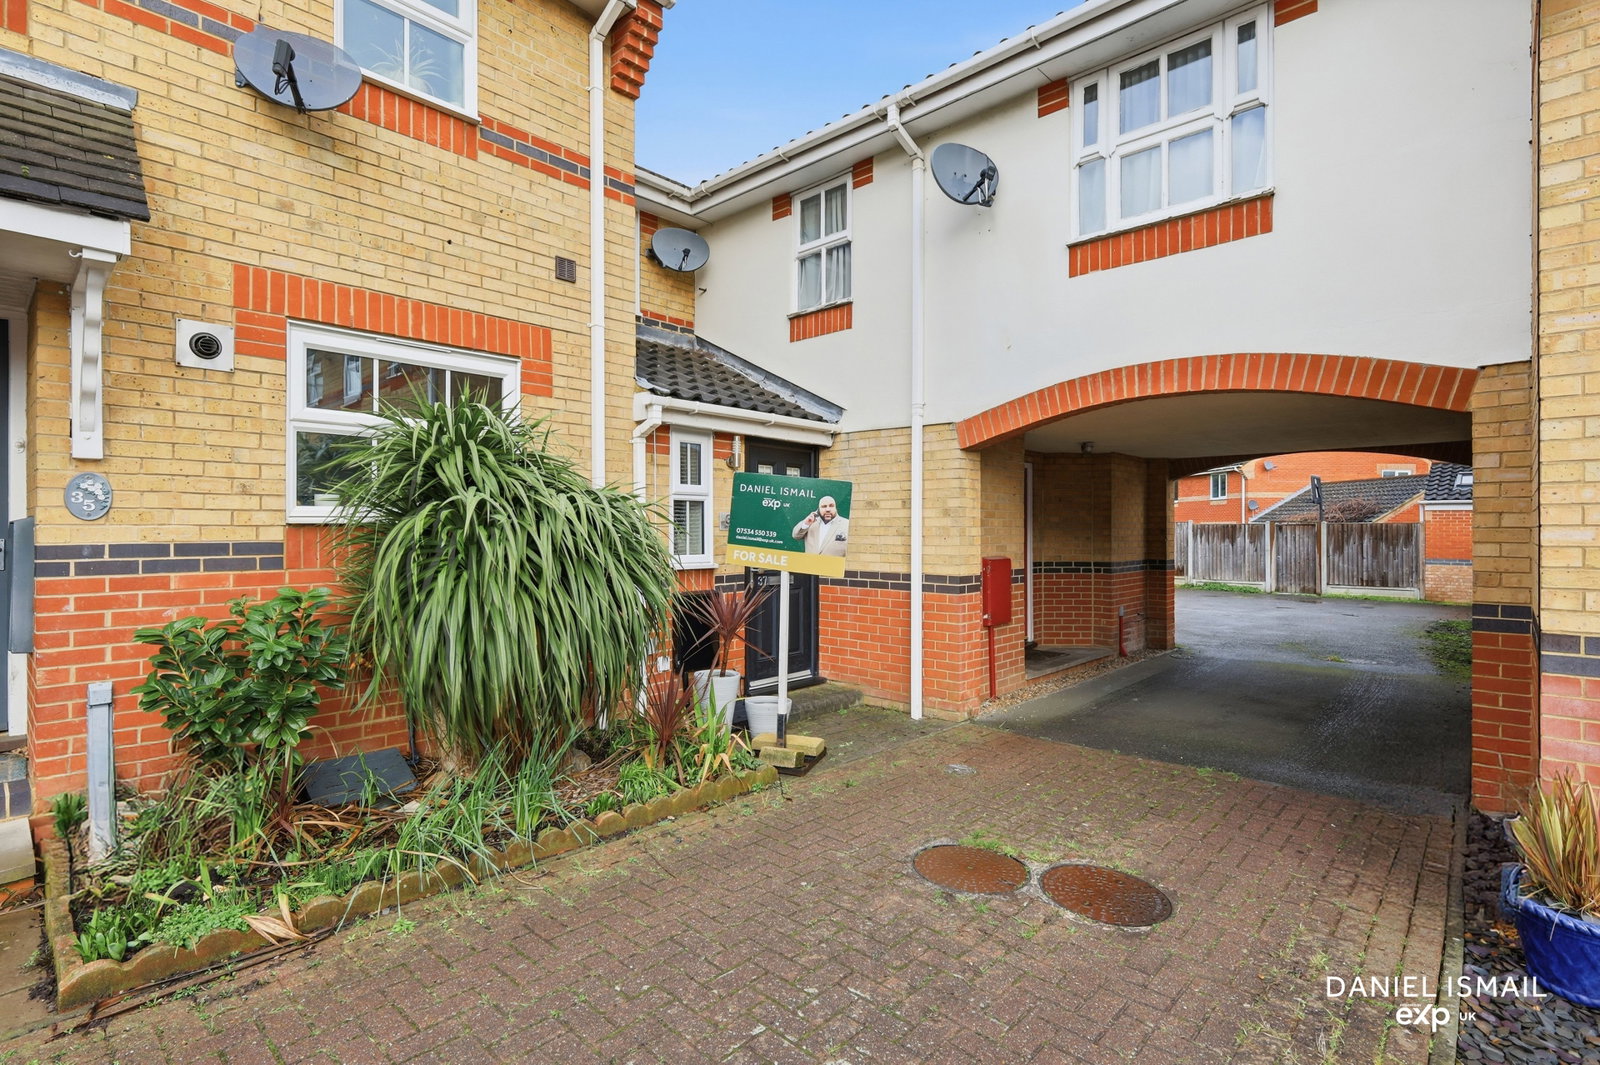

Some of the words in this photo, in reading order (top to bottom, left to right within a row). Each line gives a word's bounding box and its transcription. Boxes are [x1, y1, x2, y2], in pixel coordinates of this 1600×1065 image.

[739, 483, 777, 495] DANIEL
[780, 487, 816, 499] ISMAIL
[71, 491, 96, 511] 35
[733, 550, 757, 562] FOR
[758, 552, 789, 566] SALE
